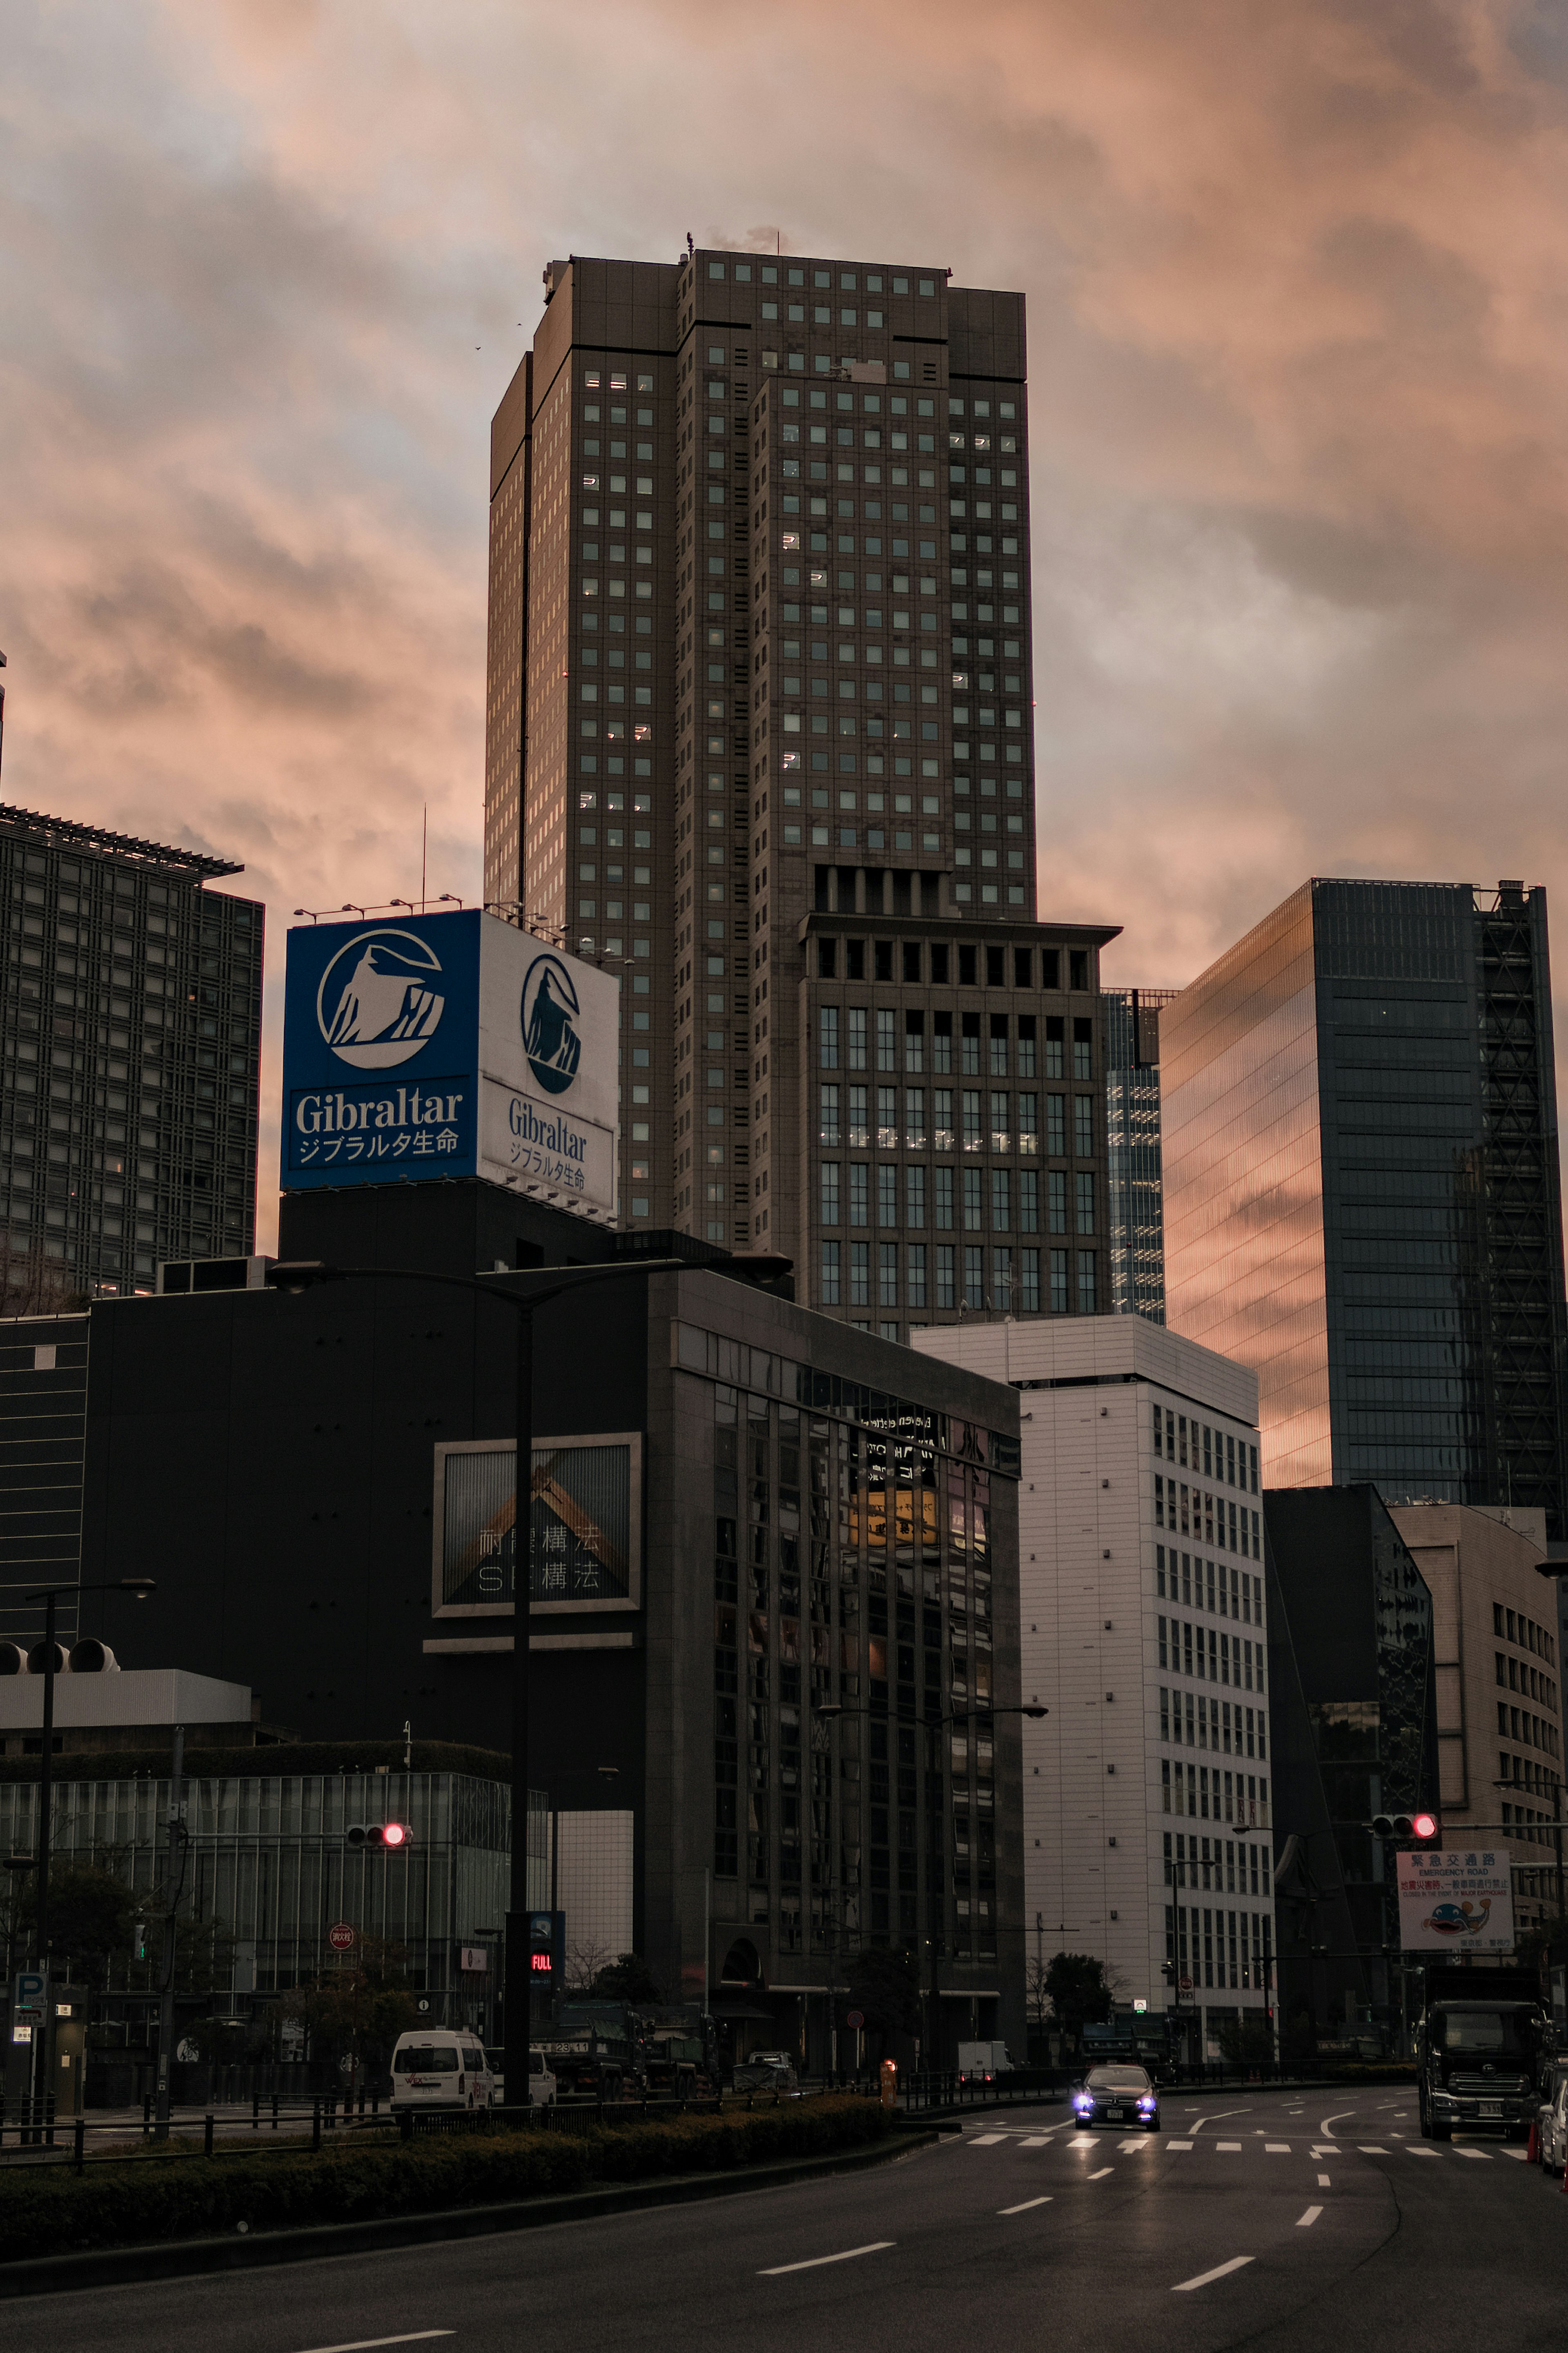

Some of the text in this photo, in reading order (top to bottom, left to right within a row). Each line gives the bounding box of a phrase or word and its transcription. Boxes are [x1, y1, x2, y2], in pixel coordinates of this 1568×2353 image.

[296, 1087, 463, 1134] Gibraltar
[509, 1098, 587, 1162] Gibraltar
[300, 1127, 459, 1164] ジブラルタ生命
[511, 1142, 585, 1191] ジブラルタ生命
[1412, 1853, 1495, 1867] 緊急交通路
[332, 1932, 351, 1942] 消火栓
[531, 1954, 552, 1971] FULL
[19, 1976, 44, 2003] P
[557, 2043, 569, 2052] 23
